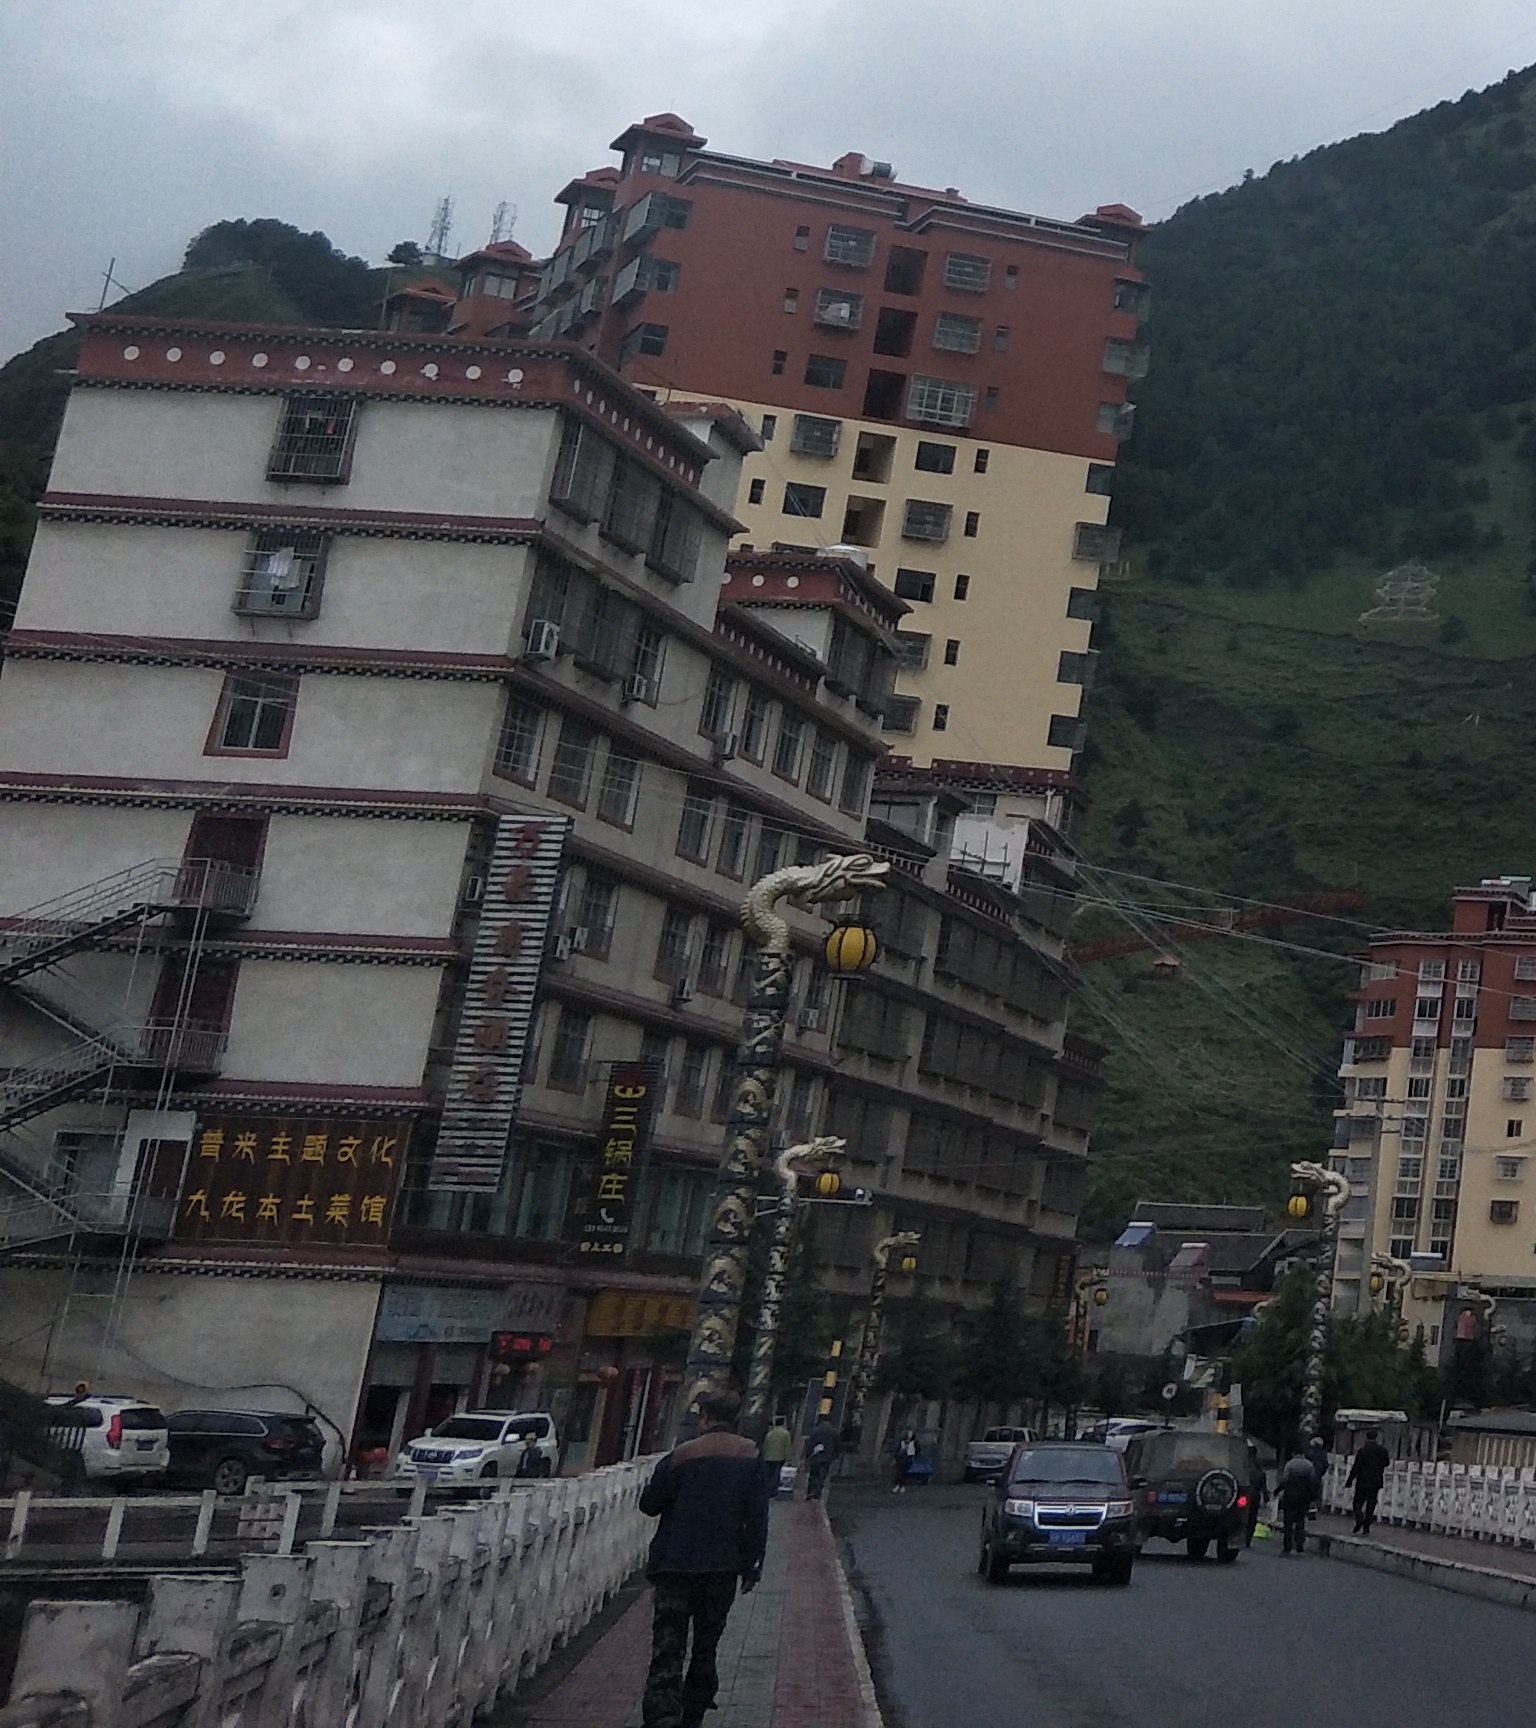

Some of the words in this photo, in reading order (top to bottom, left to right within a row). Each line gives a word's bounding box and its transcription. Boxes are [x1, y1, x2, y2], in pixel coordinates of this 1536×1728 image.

[200, 1128, 396, 1168] 普米主题文化
[186, 1189, 387, 1228] 九龙本土菜馆
